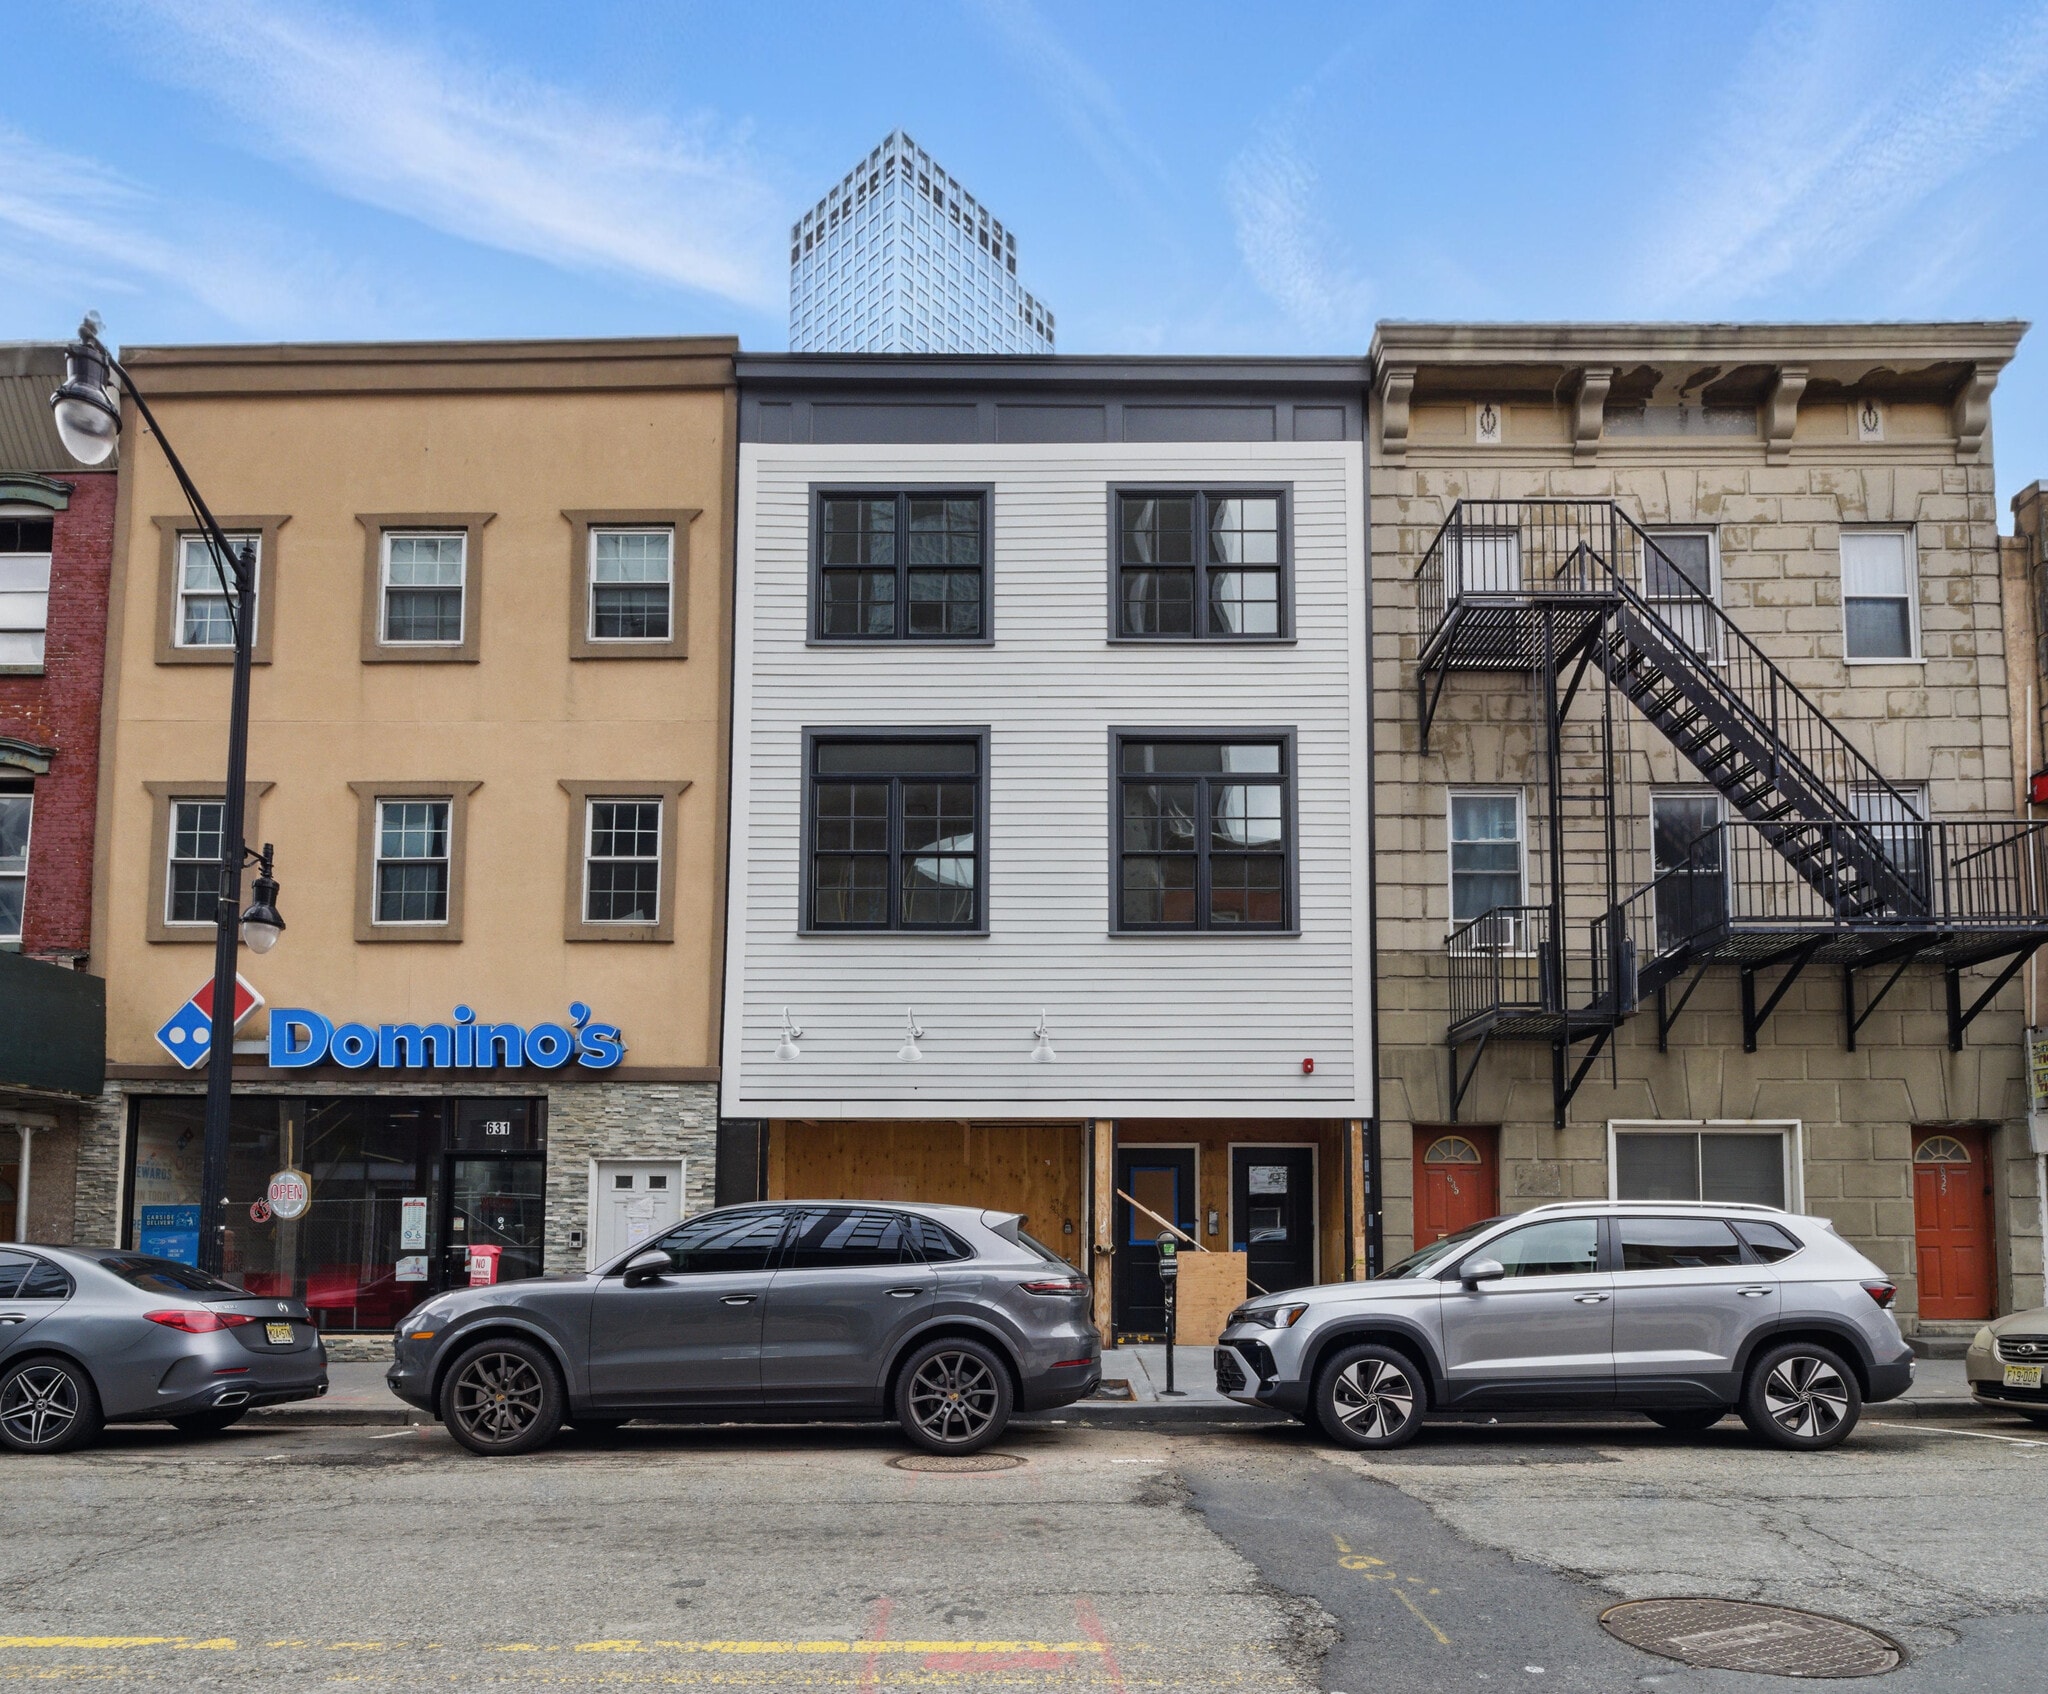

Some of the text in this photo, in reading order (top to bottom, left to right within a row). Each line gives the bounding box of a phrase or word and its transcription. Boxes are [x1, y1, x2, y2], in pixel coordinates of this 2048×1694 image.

[269, 1001, 624, 1069] Domino's
[487, 1122, 509, 1134] 631
[136, 1165, 172, 1180] EWARDS
[270, 1184, 303, 1200] OPEN
[475, 1258, 486, 1269] NO
